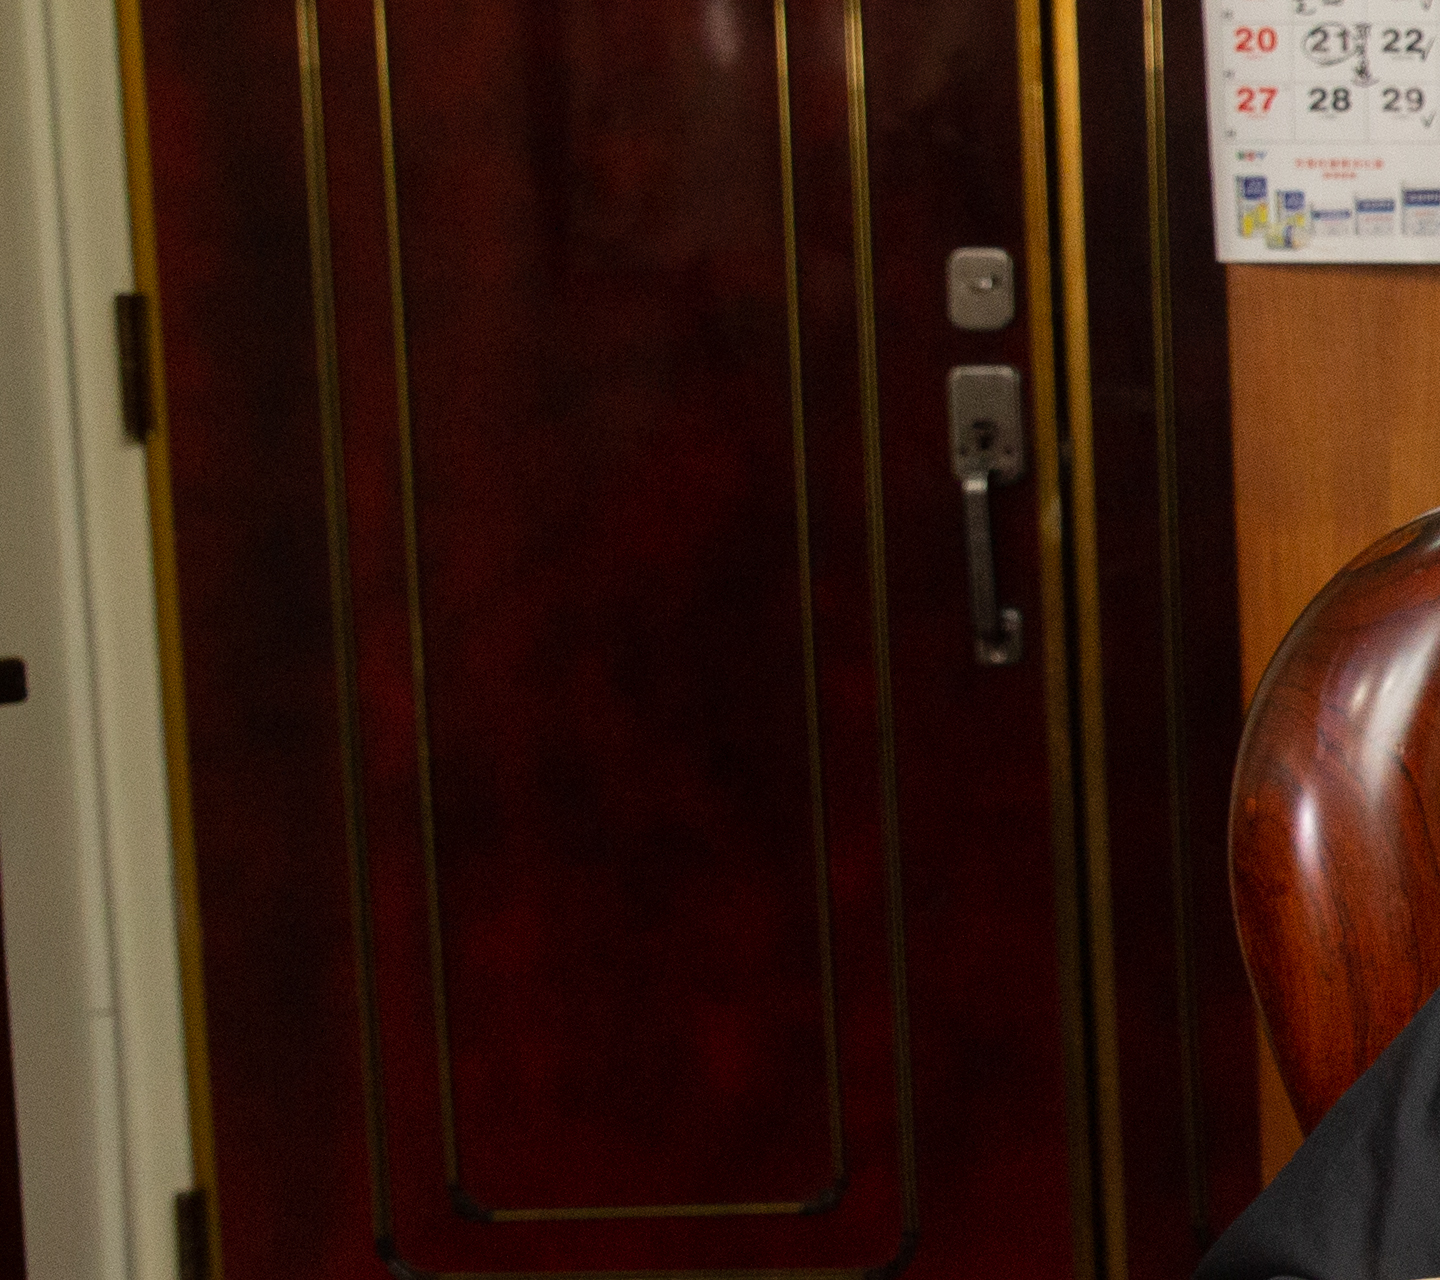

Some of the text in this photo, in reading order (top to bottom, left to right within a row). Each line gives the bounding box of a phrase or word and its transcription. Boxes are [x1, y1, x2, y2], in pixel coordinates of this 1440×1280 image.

[1236, 28, 1277, 52] 20
[1309, 27, 1349, 53] 21
[1382, 28, 1423, 53] 22
[1238, 87, 1277, 113] 27
[1309, 88, 1351, 112] 28
[1382, 87, 1424, 111] 29
